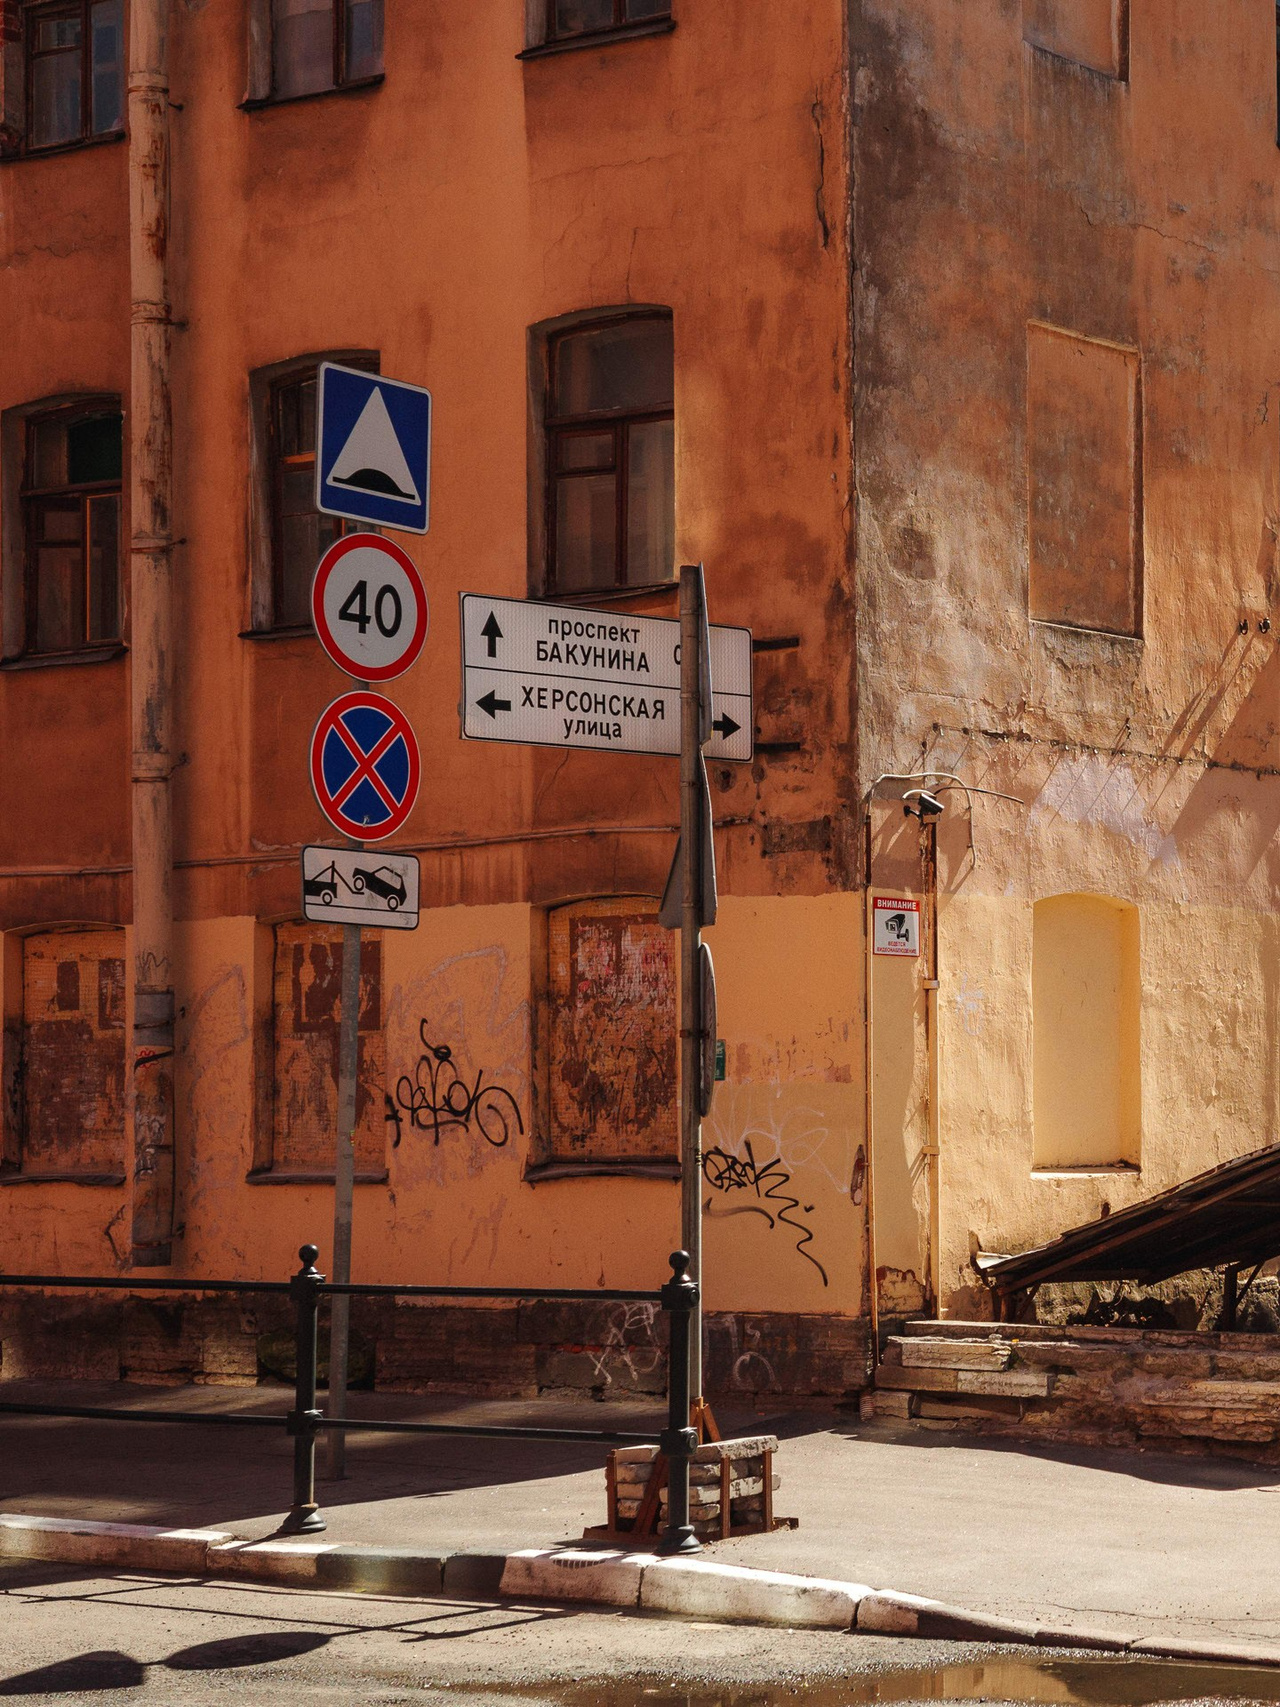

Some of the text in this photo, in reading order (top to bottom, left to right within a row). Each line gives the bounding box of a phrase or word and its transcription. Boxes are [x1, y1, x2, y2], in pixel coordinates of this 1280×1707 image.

[338, 580, 402, 638] 40
[548, 618, 641, 643] проспект
[536, 640, 650, 673] БАКУНИНА
[521, 685, 666, 720] ХЕРСОНСКАЯ
[563, 717, 622, 740] улица
[877, 899, 917, 910] ВНИМАНИЕ
